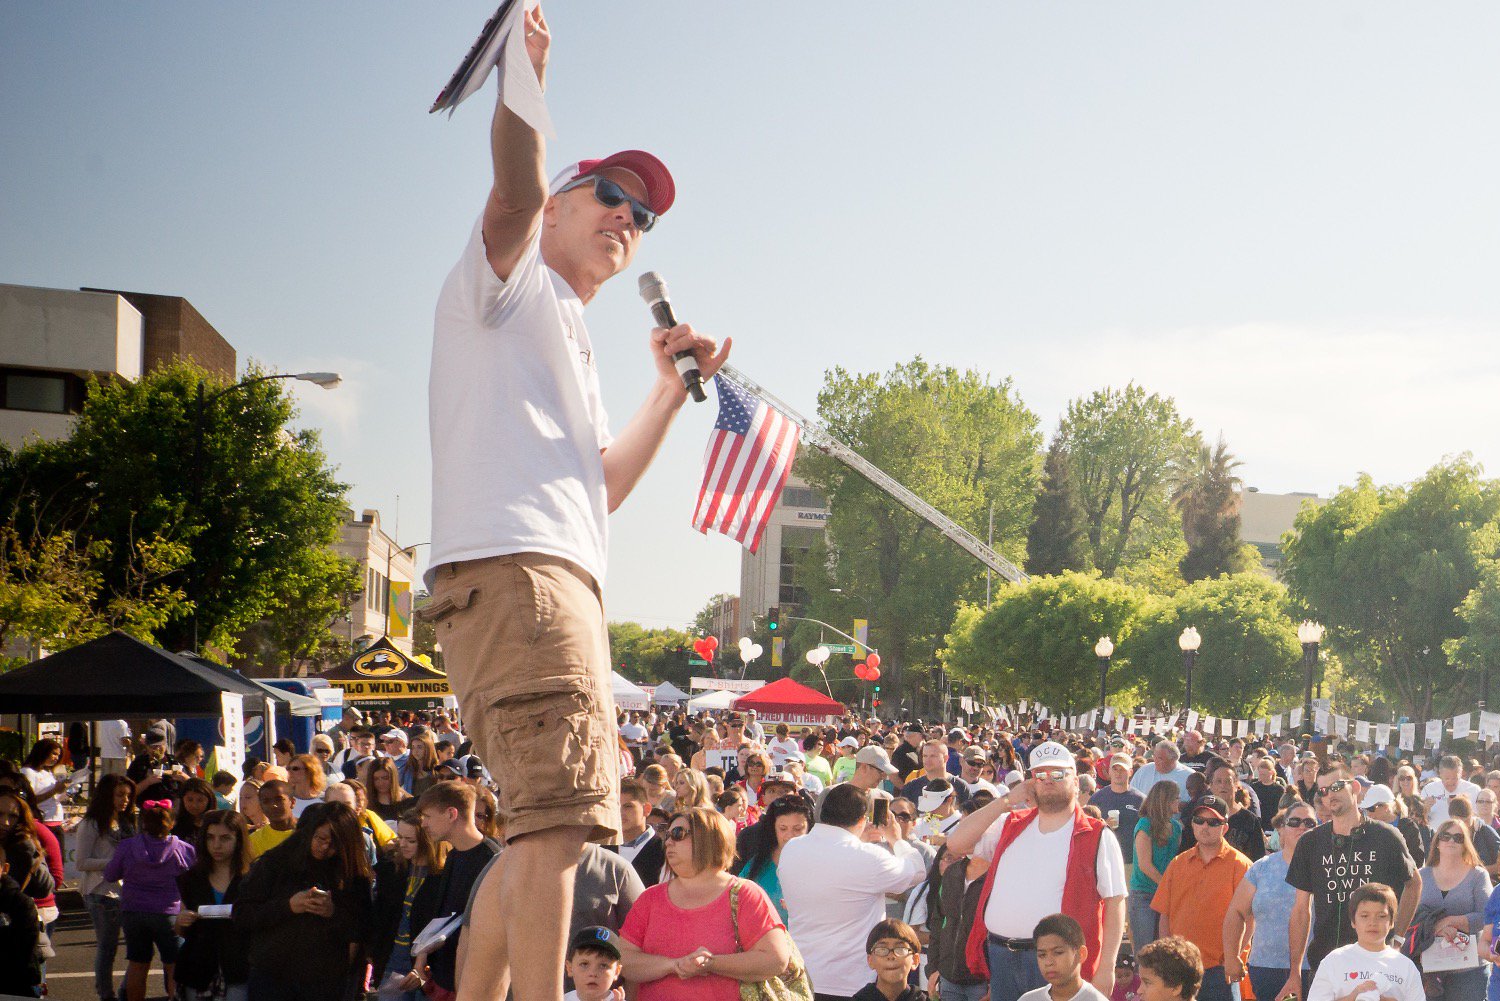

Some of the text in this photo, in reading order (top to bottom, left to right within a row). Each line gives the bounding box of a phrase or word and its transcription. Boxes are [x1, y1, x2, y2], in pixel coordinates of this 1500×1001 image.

[369, 683, 402, 693] WILD
[407, 682, 449, 693] WINGS
[1322, 851, 1377, 865] MAKE
[1324, 864, 1373, 878] YOUR
[1327, 878, 1370, 891] OWN
[1327, 891, 1355, 904] LU
